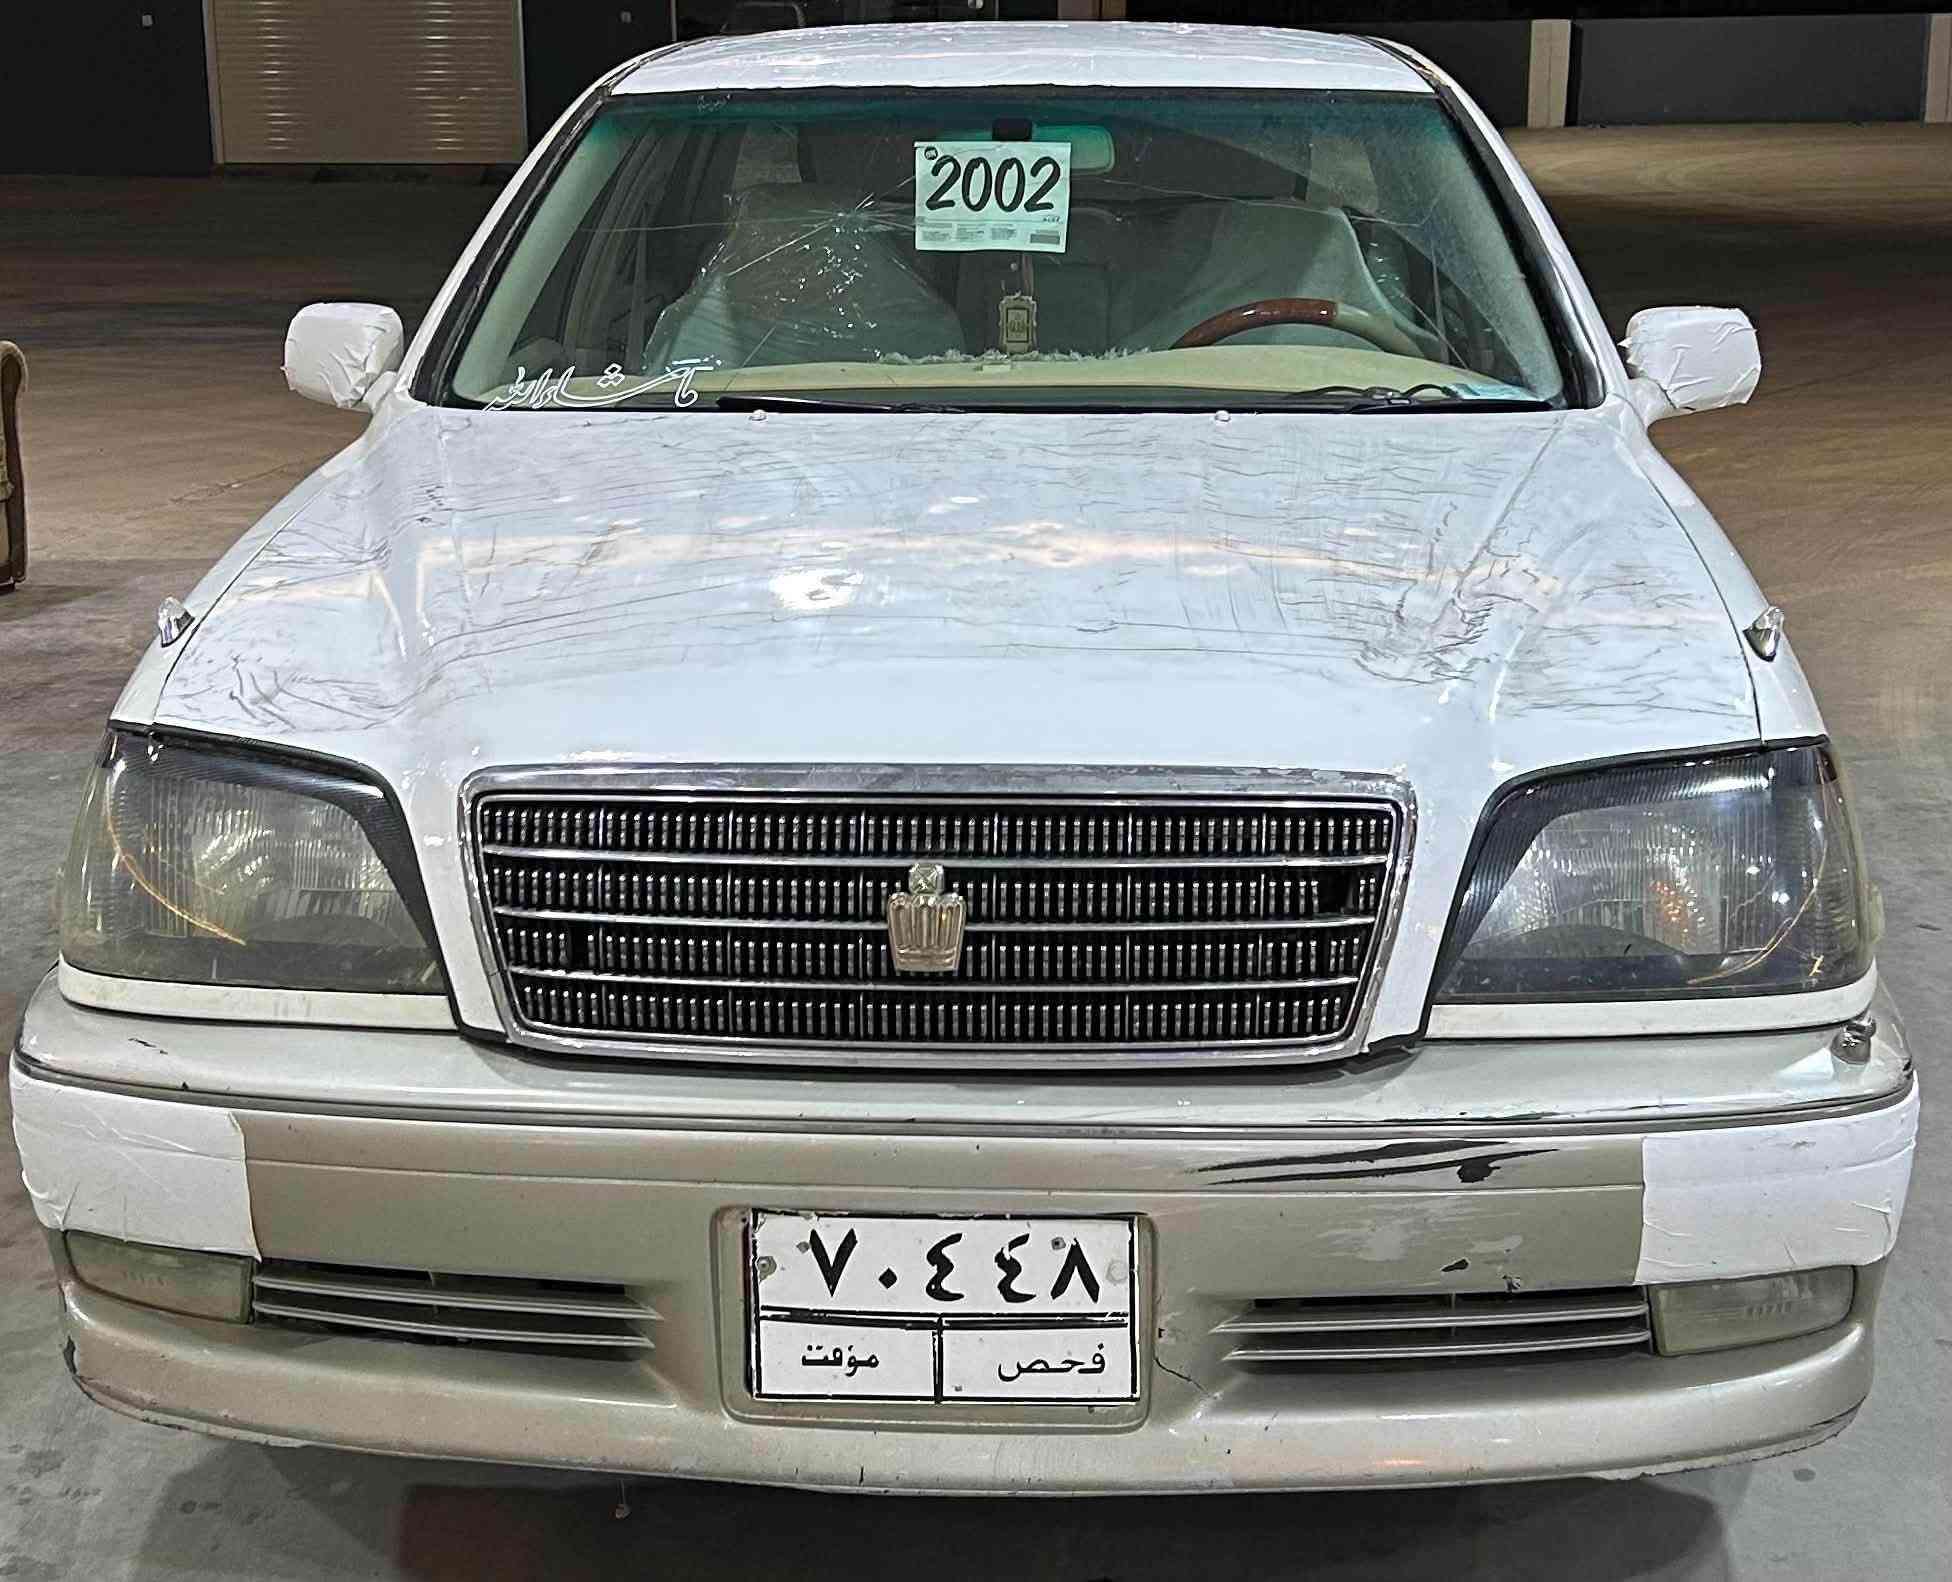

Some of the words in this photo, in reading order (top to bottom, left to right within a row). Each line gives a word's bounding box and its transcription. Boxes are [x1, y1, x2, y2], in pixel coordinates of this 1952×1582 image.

[926, 154, 1061, 212] 2002
[809, 1228, 1100, 1303] ٧٠٤٤٨
[997, 1342, 1106, 1382] فحص
